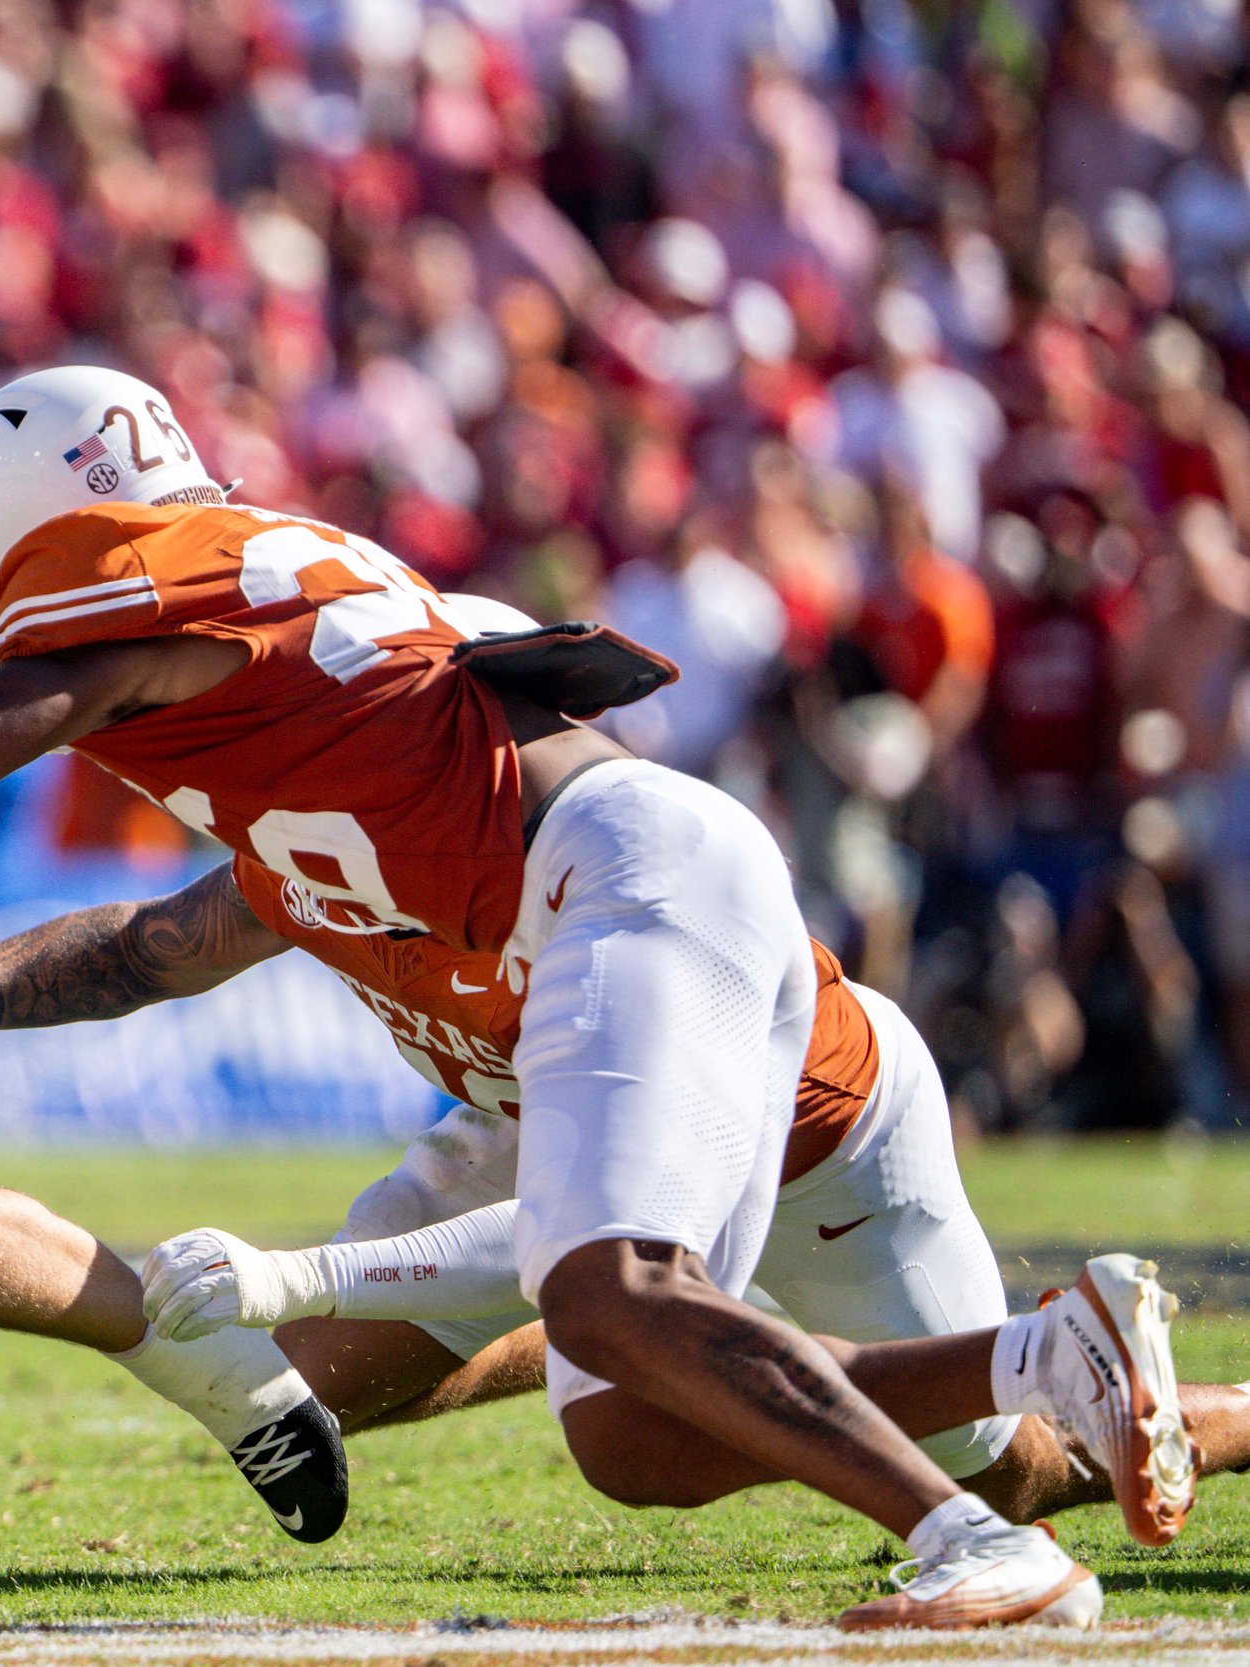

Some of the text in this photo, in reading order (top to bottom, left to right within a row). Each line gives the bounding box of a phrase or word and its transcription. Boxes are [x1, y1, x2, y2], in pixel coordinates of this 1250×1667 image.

[103, 399, 191, 474] 26
[86, 463, 120, 495] SEC
[327, 964, 515, 1076] TEXAS
[363, 1263, 438, 1282] HOOK 'EM!
